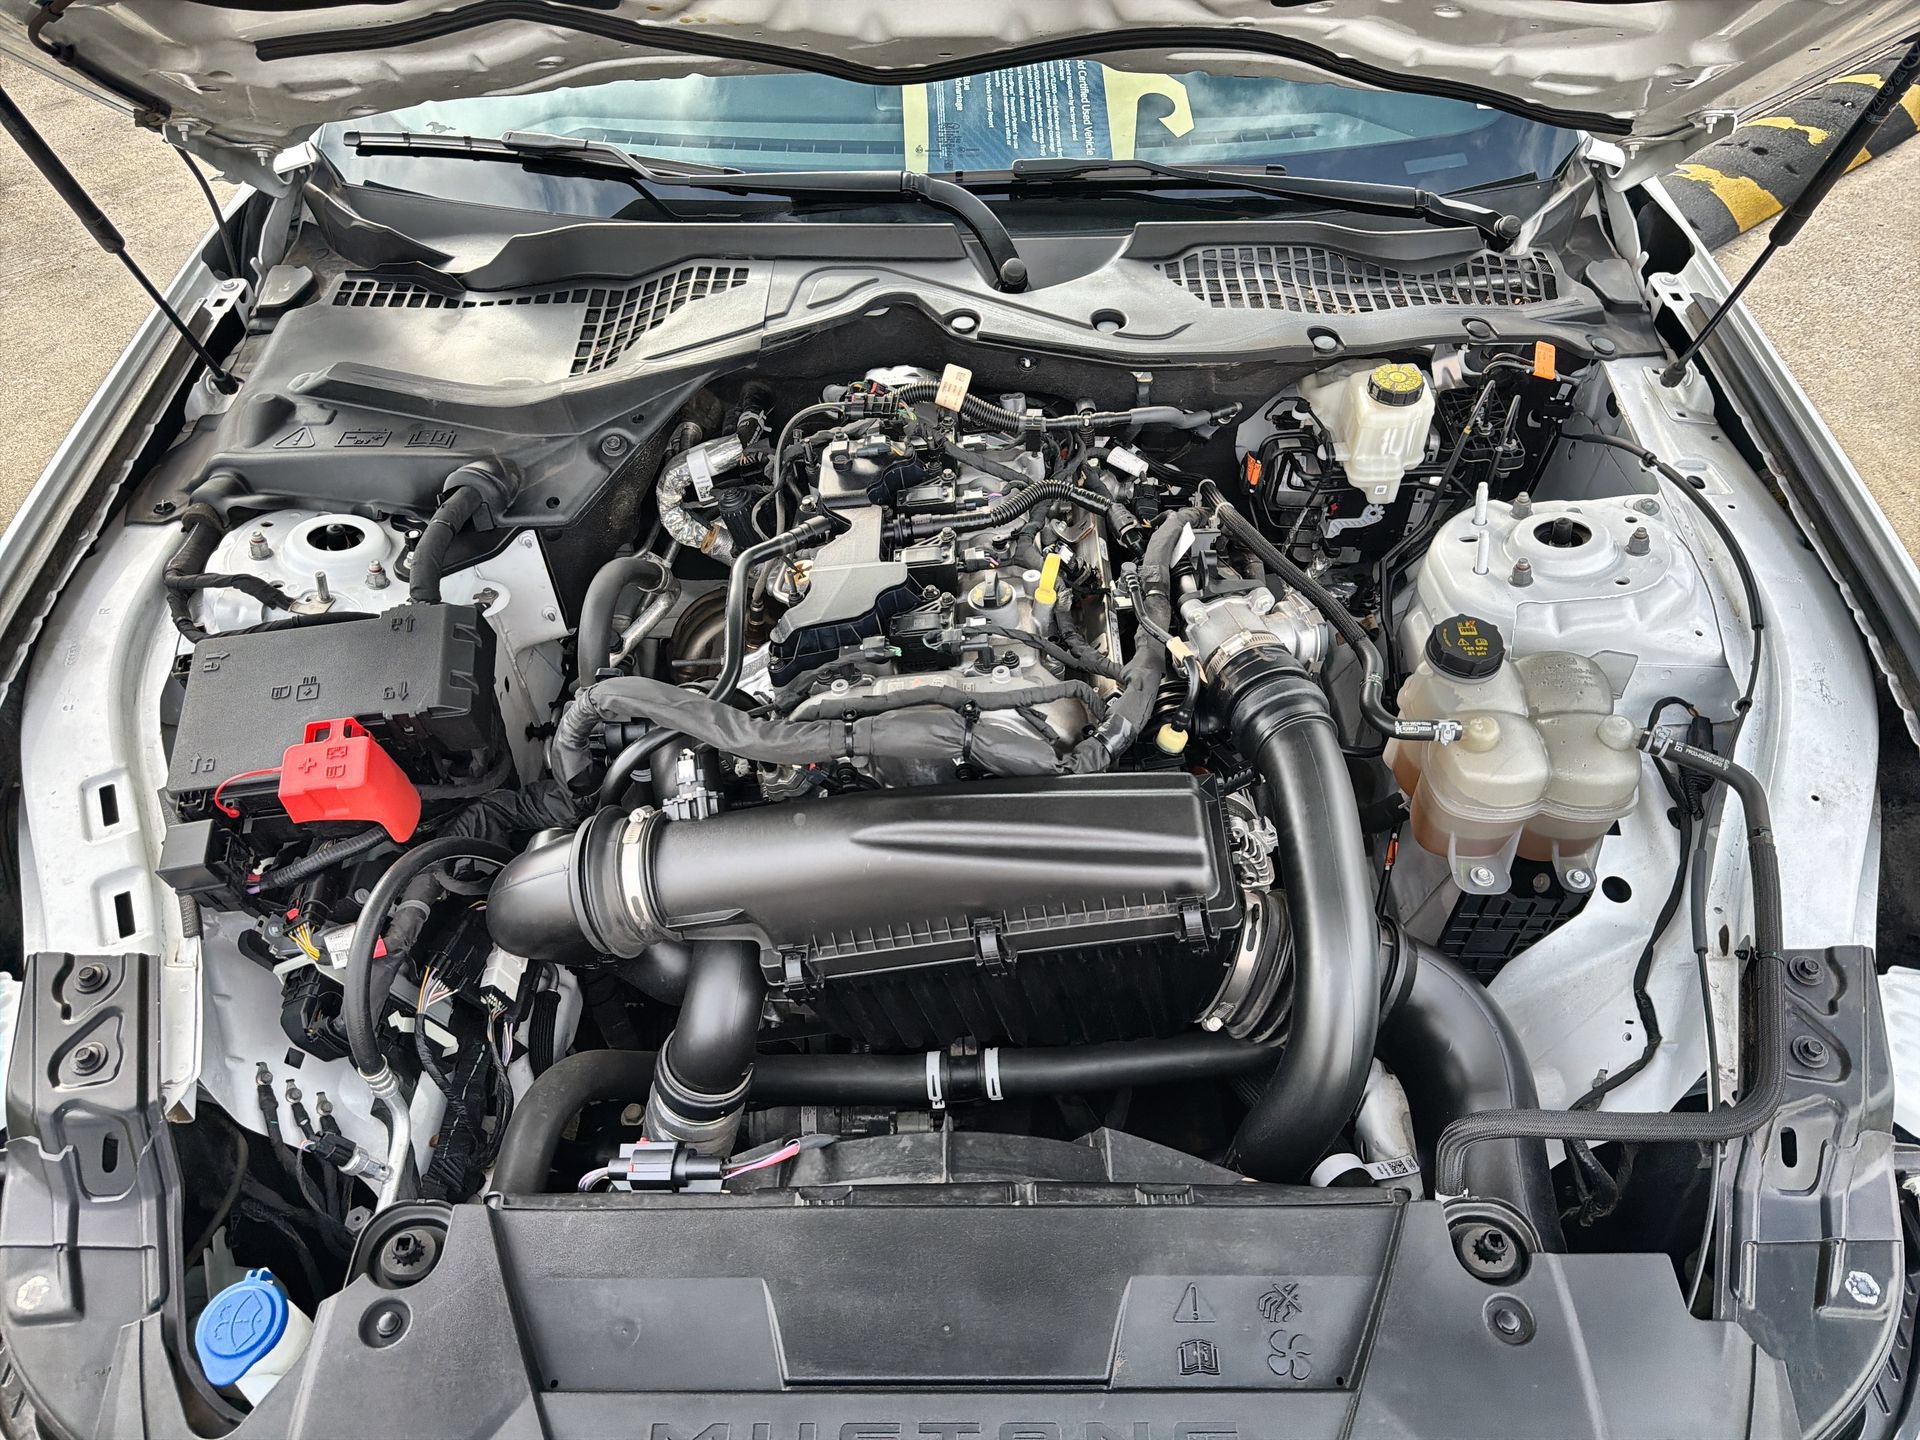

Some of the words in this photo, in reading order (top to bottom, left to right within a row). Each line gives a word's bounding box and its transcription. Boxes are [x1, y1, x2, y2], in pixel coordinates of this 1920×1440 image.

[963, 76, 971, 91] Blue
[1001, 73, 1009, 96] scheduled
[1017, 75, 1025, 96] Roadside
[1027, 80, 1035, 98] Limited
[1078, 70, 1090, 103] Certified
[1029, 98, 1037, 119] Warranty
[1081, 104, 1093, 125] Used
[1046, 109, 1054, 130] Warranty
[1084, 126, 1096, 156] Vehicle
